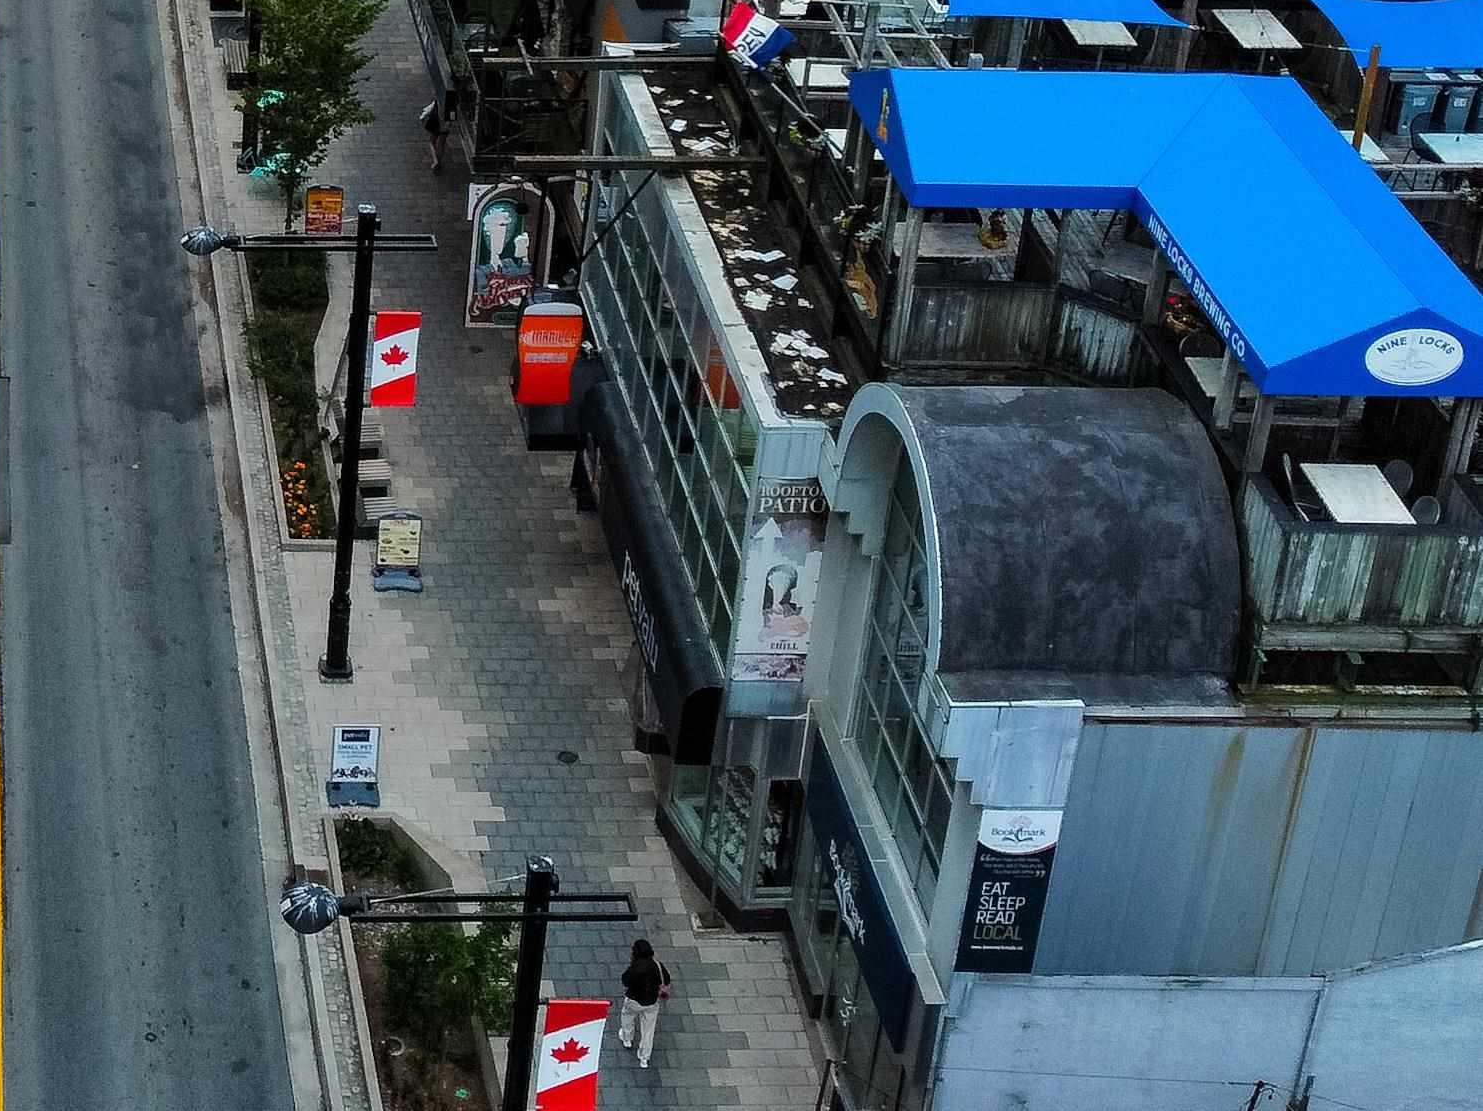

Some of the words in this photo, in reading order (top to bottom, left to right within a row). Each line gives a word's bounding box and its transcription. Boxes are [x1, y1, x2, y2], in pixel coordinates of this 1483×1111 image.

[1147, 214, 1168, 249] NINE
[1167, 240, 1194, 284] LOCKS
[1193, 276, 1232, 337] BREWING
[1231, 333, 1246, 362] CO.
[1376, 336, 1407, 354] NINE
[1418, 335, 1456, 354] LOCKS
[759, 485, 821, 497] ROOFTO
[758, 497, 827, 514] PATIO
[982, 882, 1011, 896] EAT
[978, 896, 1026, 911] SLEEP
[975, 910, 1016, 925] READ
[973, 925, 1022, 941] LOCAL
